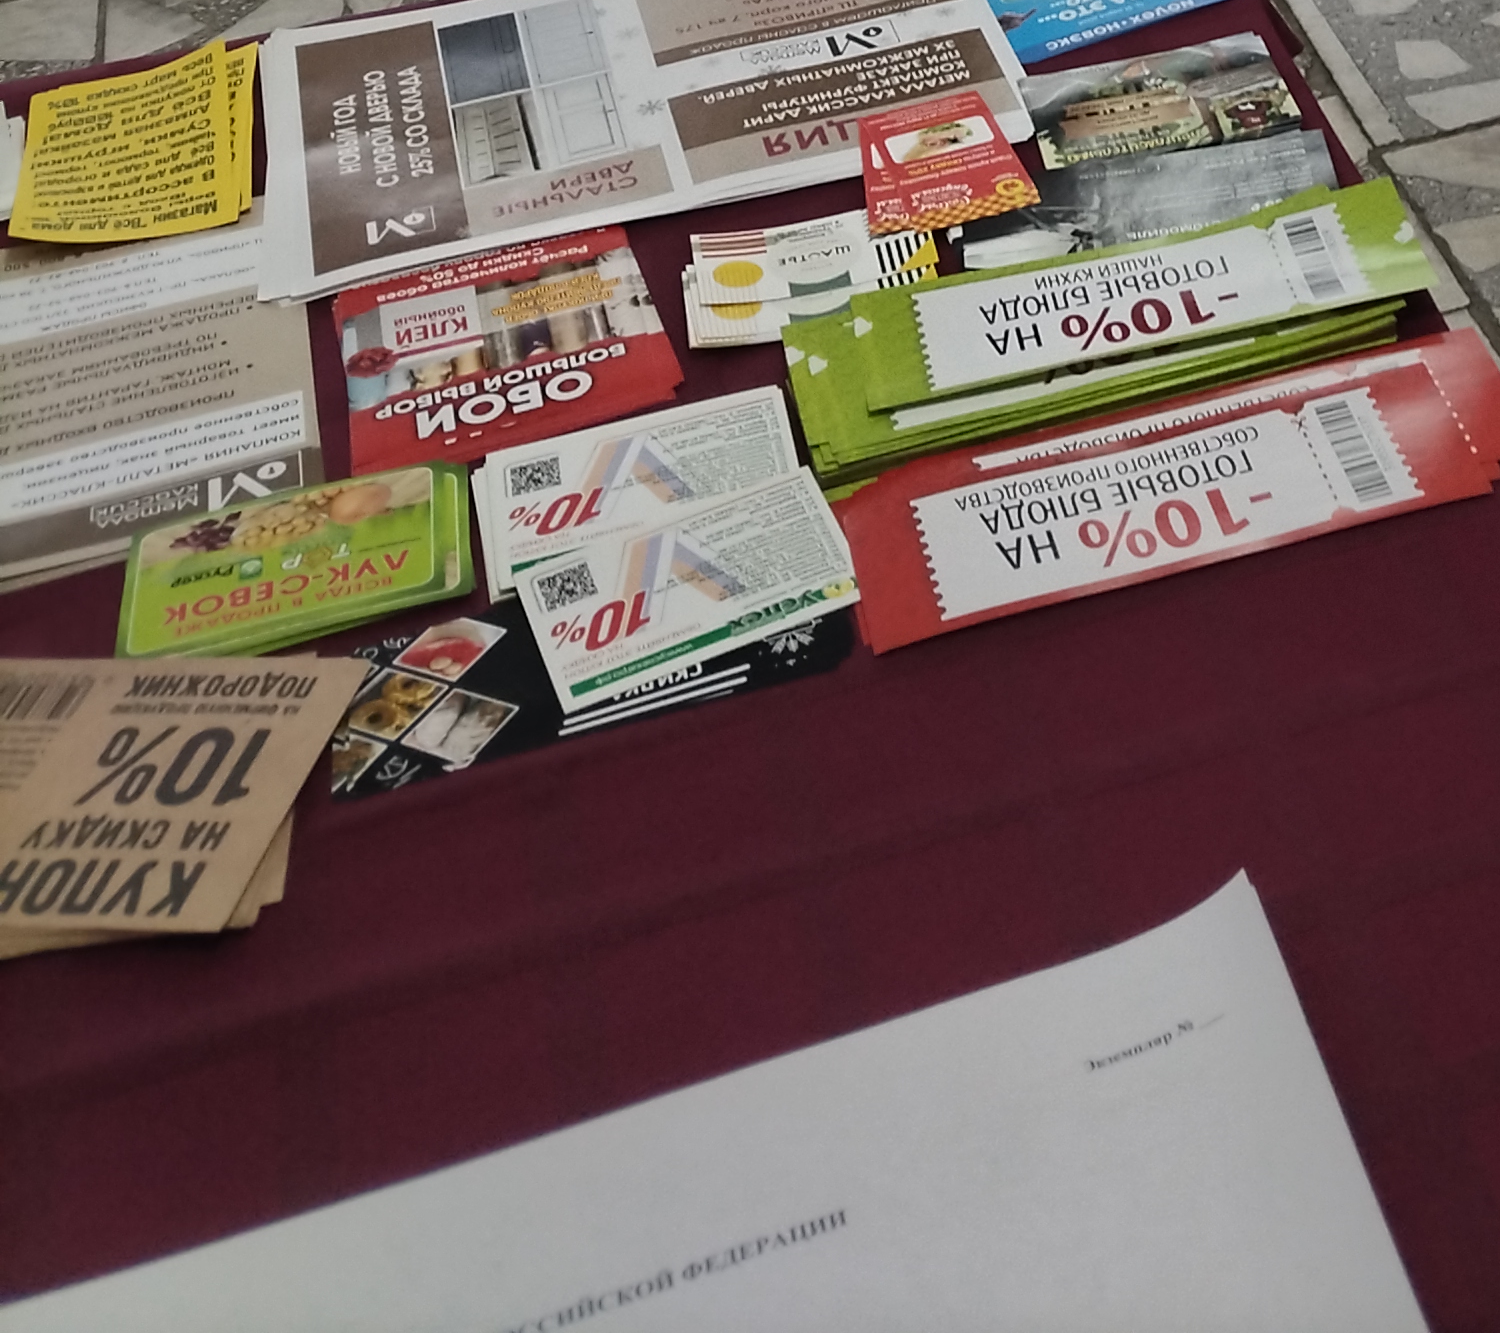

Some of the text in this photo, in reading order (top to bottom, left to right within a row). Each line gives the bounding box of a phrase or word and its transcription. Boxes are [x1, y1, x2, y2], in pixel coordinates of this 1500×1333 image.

[143, 70, 177, 88] март
[182, 53, 213, 71] Весь
[191, 66, 214, 78] При
[773, 45, 928, 87] МЕЖКОМНАТНЫХ
[856, 49, 961, 80] ПРИ ЗАКАЗЕ
[86, 83, 138, 101] скидка
[199, 76, 216, 88] От
[742, 70, 970, 129] МЕТАЛЛ КЛАССИК ДАРИТ
[761, 60, 965, 112] КОМПЛЕКТ ФУРНИТУРЫ
[121, 105, 163, 125] для
[173, 90, 211, 111] Всё
[123, 103, 209, 136] Алмазная
[139, 118, 210, 145] Сумки,
[329, 94, 361, 175] НОВЫЙ ГОД
[363, 70, 400, 188] С НОВОЙ ДВЕРЬЮ
[397, 65, 434, 177] 25% СО СКЛАДА
[155, 151, 180, 165] для
[190, 141, 215, 156] Всё
[108, 154, 215, 190] Одежда для детей
[116, 162, 149, 176] сада
[203, 169, 215, 180] В
[549, 160, 634, 191] ДВЕРИ
[153, 199, 218, 223] Магазин
[491, 175, 638, 219] СТАЛЬНЫЕ
[31, 220, 74, 232] дома
[79, 219, 108, 231] для
[457, 262, 479, 273] до
[483, 246, 544, 267] Скидки
[532, 243, 588, 265] Расчёт
[1033, 253, 1162, 291] НАШЕЙ КУХНИ
[431, 257, 527, 289] количества
[977, 255, 1229, 325] ГОТОВЫЕ БЛЮДА
[376, 284, 427, 303] обоев
[394, 304, 465, 328] обойный
[395, 316, 468, 349] КЛЕЙ
[984, 285, 1239, 357] -10% НА
[11, 314, 165, 360] ПРОИЗВОДИТЕЛЕЙ
[14, 307, 240, 370] ПРОДАЖА МЕЖКОМНАТНЫХ
[70, 332, 217, 376] ПО ТРЕБОВАНИЯМ
[56, 343, 214, 392] ИНДИВИДУАЛЬНЫЕ
[112, 366, 239, 405] ИЗГОТОВЛЕНИЕ
[374, 342, 626, 420] БОЛЬШОЙ ВЫБОР
[16, 400, 105, 426] СТАЛЬНЫХ
[38, 377, 150, 415] ГАРАНТИЯ НА
[16, 389, 234, 450] ПРОИЗВОДСТВО ВХОДНЫХ
[69, 399, 299, 463] собственное производство
[252, 414, 300, 432] имеет
[163, 428, 244, 455] товарный
[203, 429, 301, 462] КОМПАНИЯ
[1115, 425, 1260, 475] СОБСТВЕННОГО
[954, 463, 1110, 512] ПРОИЗВОДСТВА
[979, 448, 1254, 535] ГОТОВЫЕ БЛЮДА
[508, 487, 603, 536] 10%
[995, 487, 1273, 570] -10% НА
[164, 550, 409, 624] ЛУК-СЕВОК
[174, 575, 392, 637] ВСЕГДА В ПРОДАЖЕ
[551, 590, 651, 651] 10%
[123, 672, 318, 699] ПОДОРОЖНИК
[73, 725, 271, 807] 10%
[18, 814, 231, 851] НА СКИДКУ
[682, 1209, 847, 1282] ФЕДЕРАЦИИ
